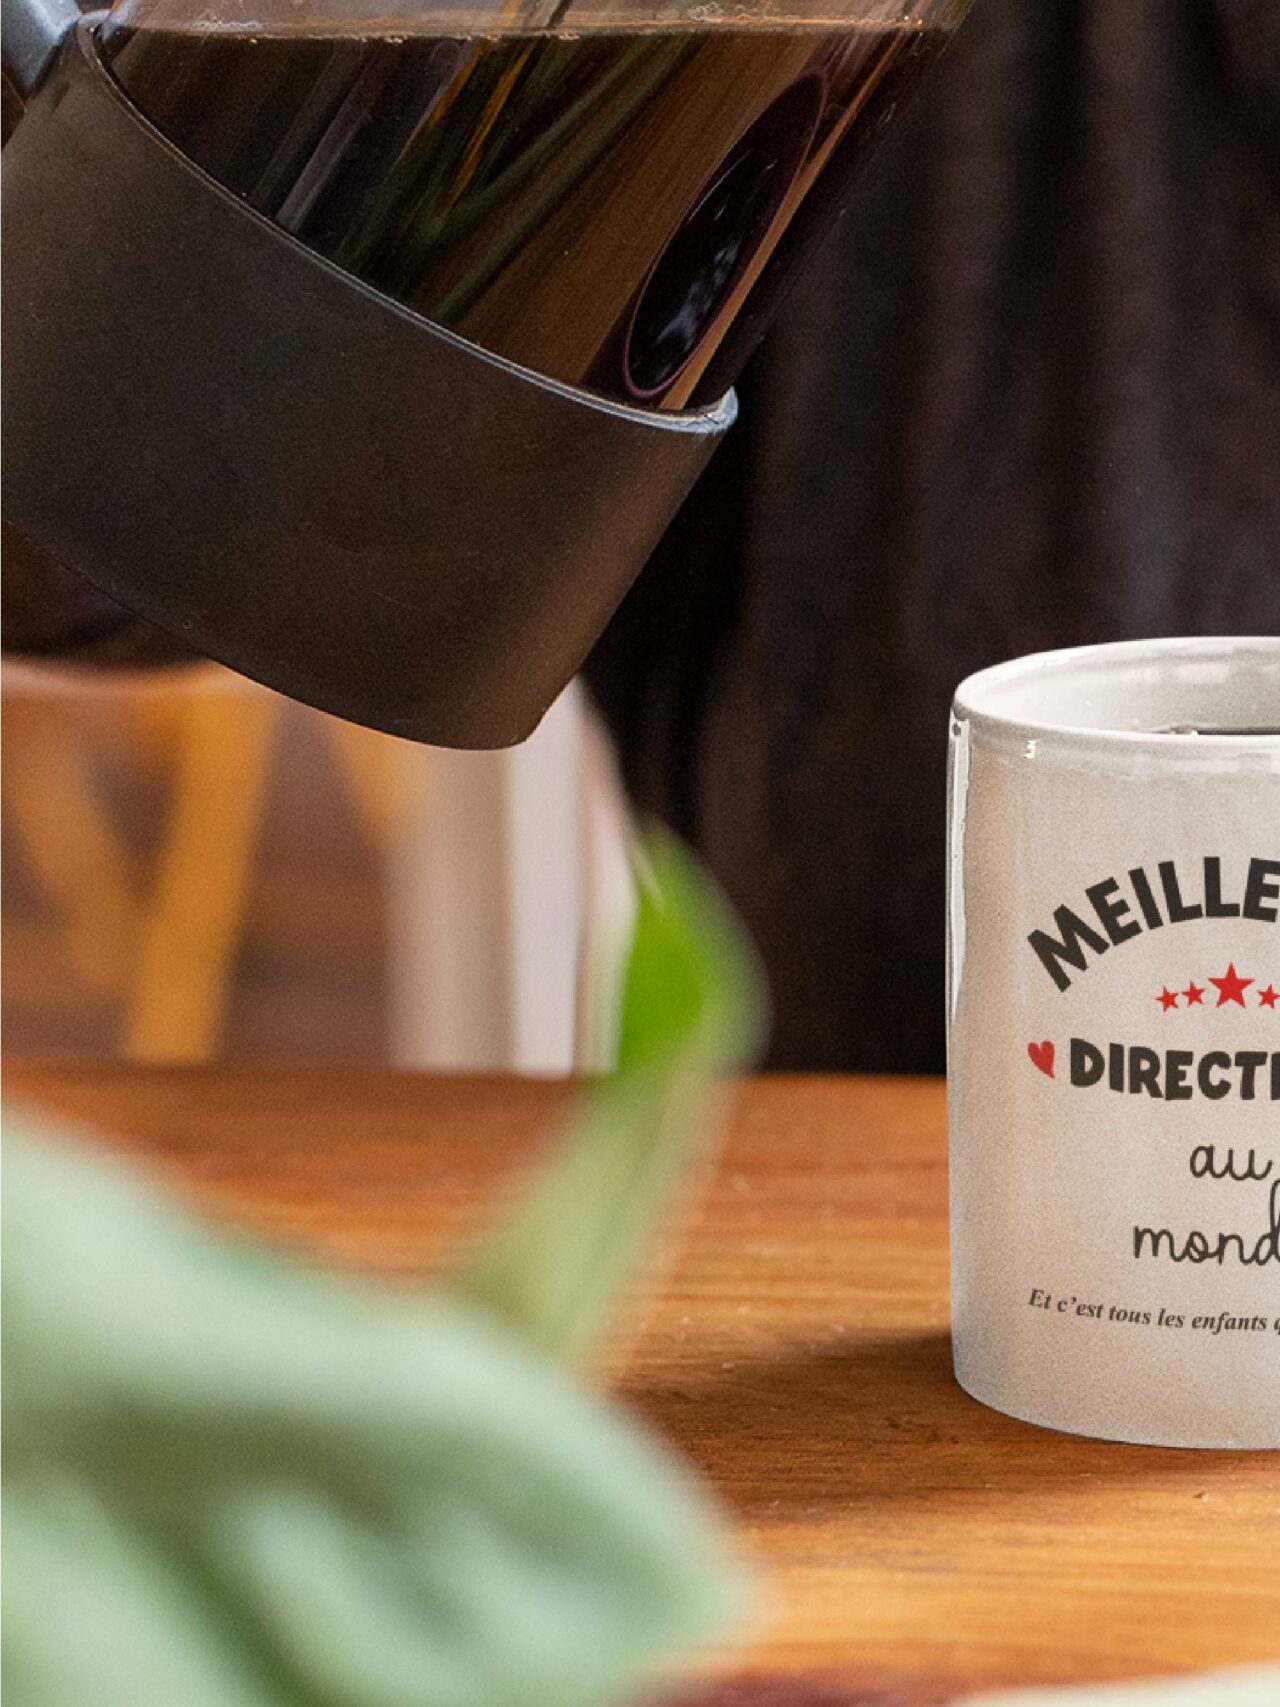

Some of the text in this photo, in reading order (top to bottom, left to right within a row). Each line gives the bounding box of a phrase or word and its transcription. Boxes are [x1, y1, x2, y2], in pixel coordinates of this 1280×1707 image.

[1189, 1145, 1273, 1182] au
[1027, 1288, 1052, 1310] Et
[1108, 1305, 1152, 1325] tous
[1157, 1307, 1185, 1329] les
[1191, 1311, 1268, 1336] enfants
